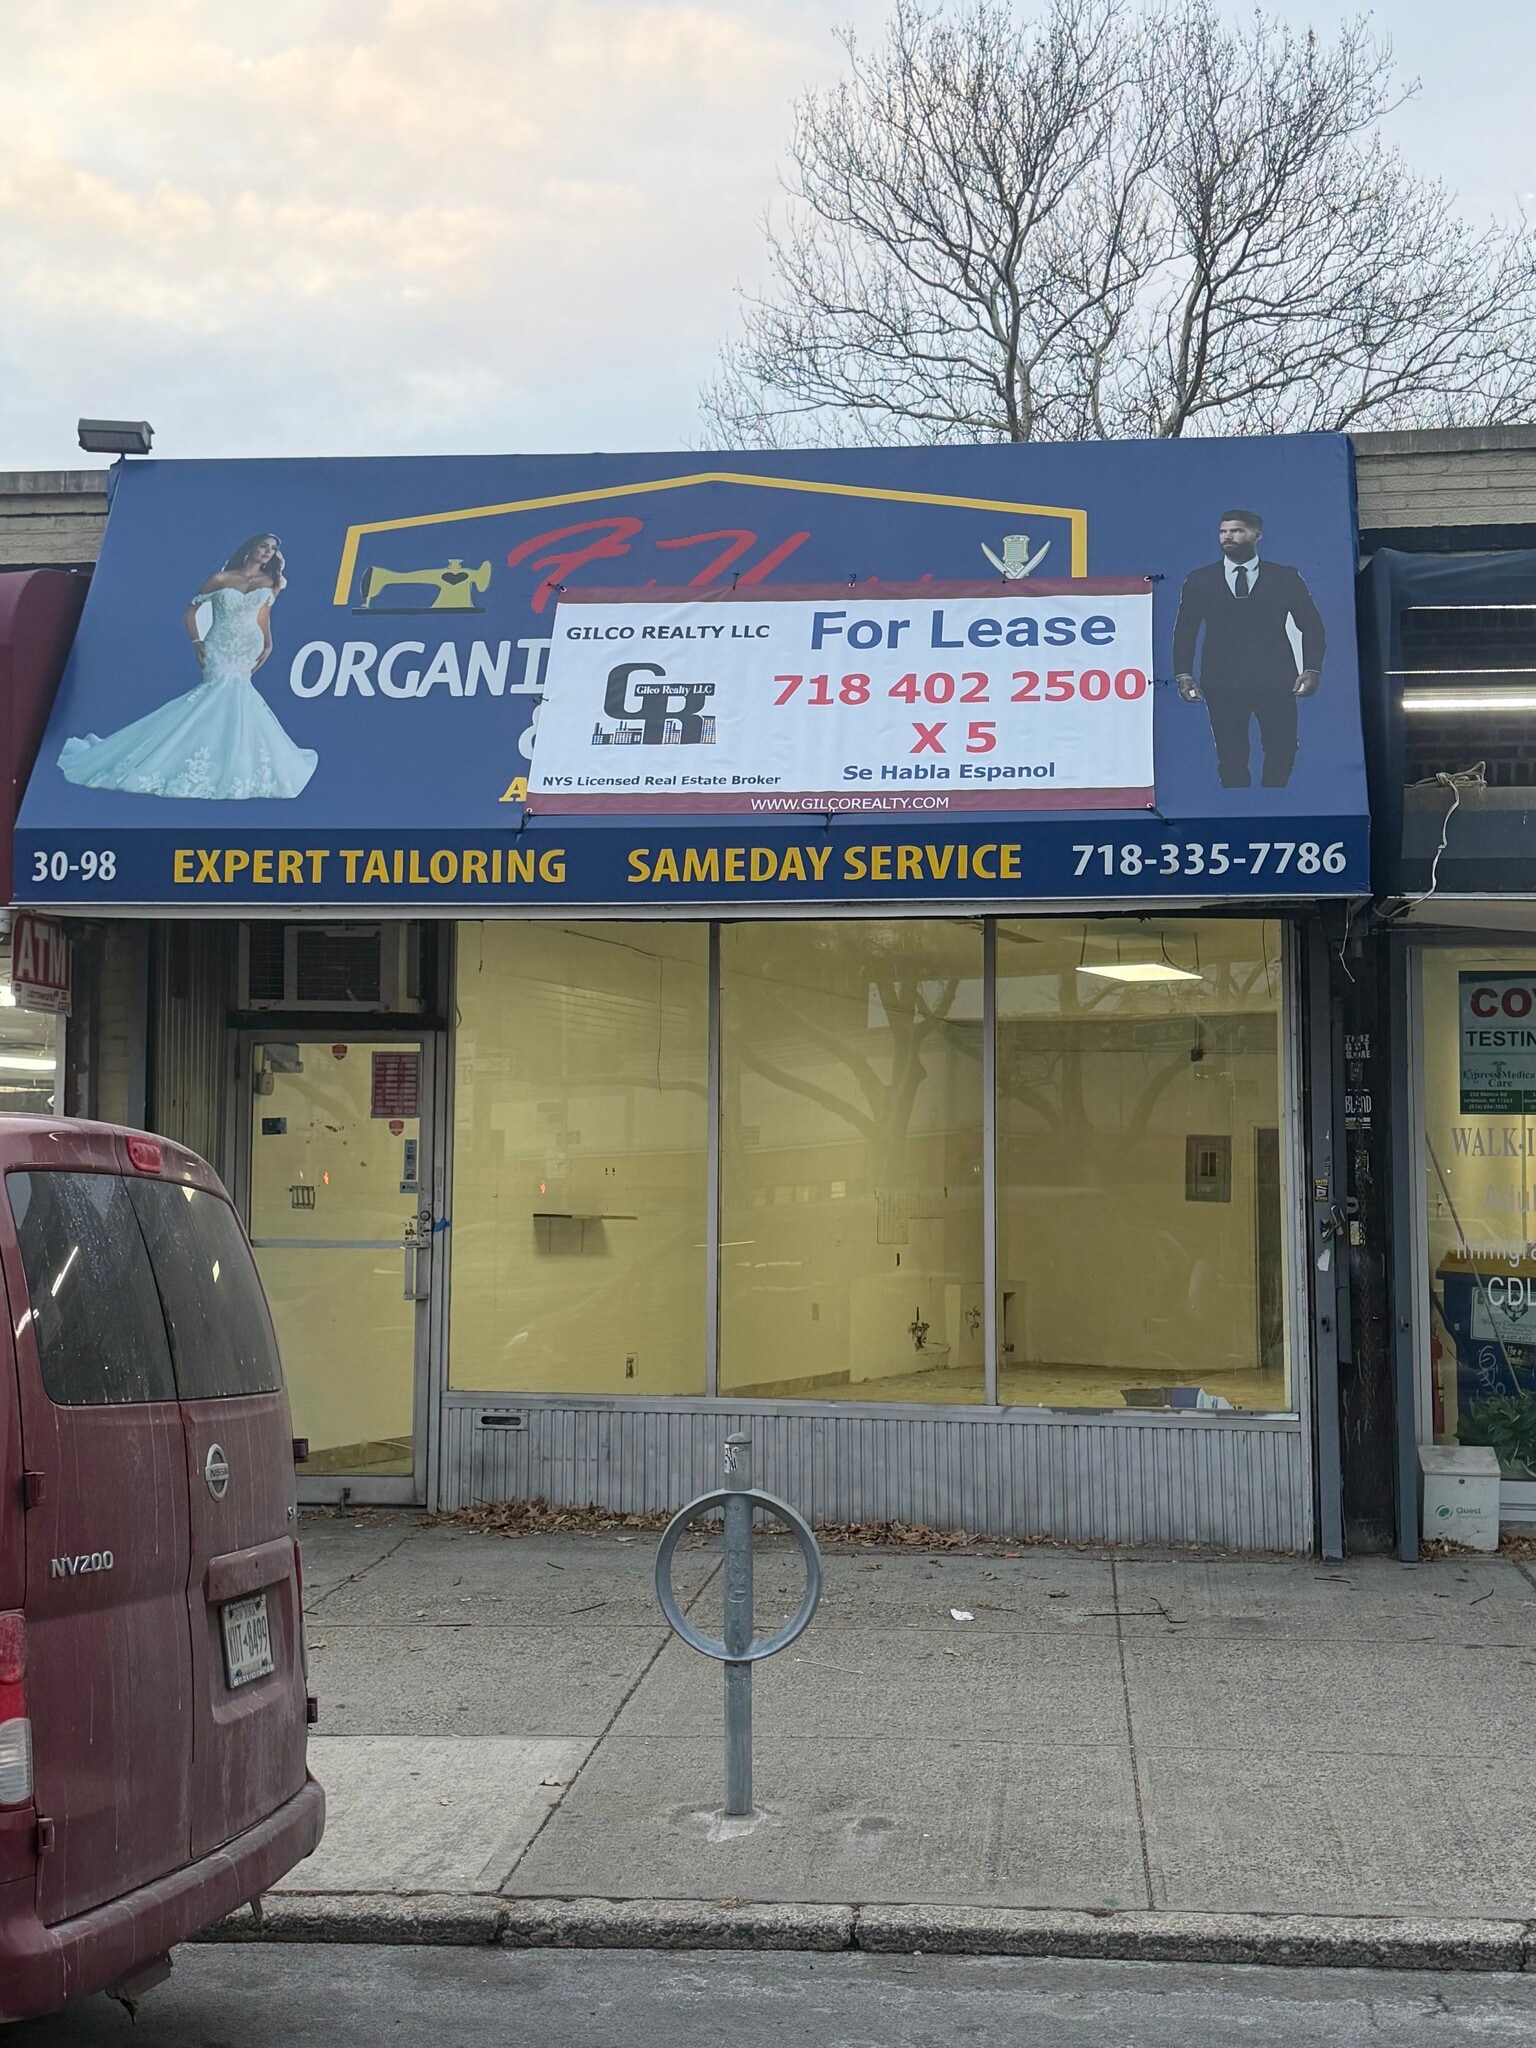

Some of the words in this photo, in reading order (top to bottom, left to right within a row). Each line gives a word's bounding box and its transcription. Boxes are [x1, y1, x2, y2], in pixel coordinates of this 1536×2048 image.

[566, 627, 636, 641] GILCO
[642, 625, 726, 640] REALTY
[731, 625, 771, 639] LLC
[810, 611, 911, 651] For
[930, 610, 1118, 650] Lease
[636, 684, 660, 695] Gilco
[662, 684, 692, 696] Realty
[693, 684, 714, 694] LLC
[772, 674, 871, 706] 718
[888, 672, 990, 705] 402
[1010, 669, 1148, 702] 2500
[909, 722, 948, 754] X
[966, 721, 998, 754] 5
[542, 776, 574, 786] NYS
[577, 775, 641, 786] Licensed
[644, 775, 677, 786] Real
[681, 775, 728, 786] Estate
[731, 774, 782, 786] Broker
[843, 765, 873, 782] Se
[881, 764, 952, 782] Habla
[960, 762, 1057, 784] Espanol
[750, 796, 950, 811] WWW.GILCOREALTY.COM
[32, 851, 118, 883] 30-98
[173, 850, 330, 885] EXPERT
[339, 849, 567, 884] TAILORING
[627, 847, 834, 883] SAMEDAY
[844, 845, 1022, 881] SERVICE
[1072, 842, 1348, 877] 718-335-7786
[17, 920, 67, 988] ATM
[1470, 987, 1536, 1018] CO
[1463, 1068, 1499, 1083] Express
[1488, 1078, 1513, 1088] Care
[1487, 1276, 1536, 1306] CDL
[50, 1550, 114, 1578] NV200
